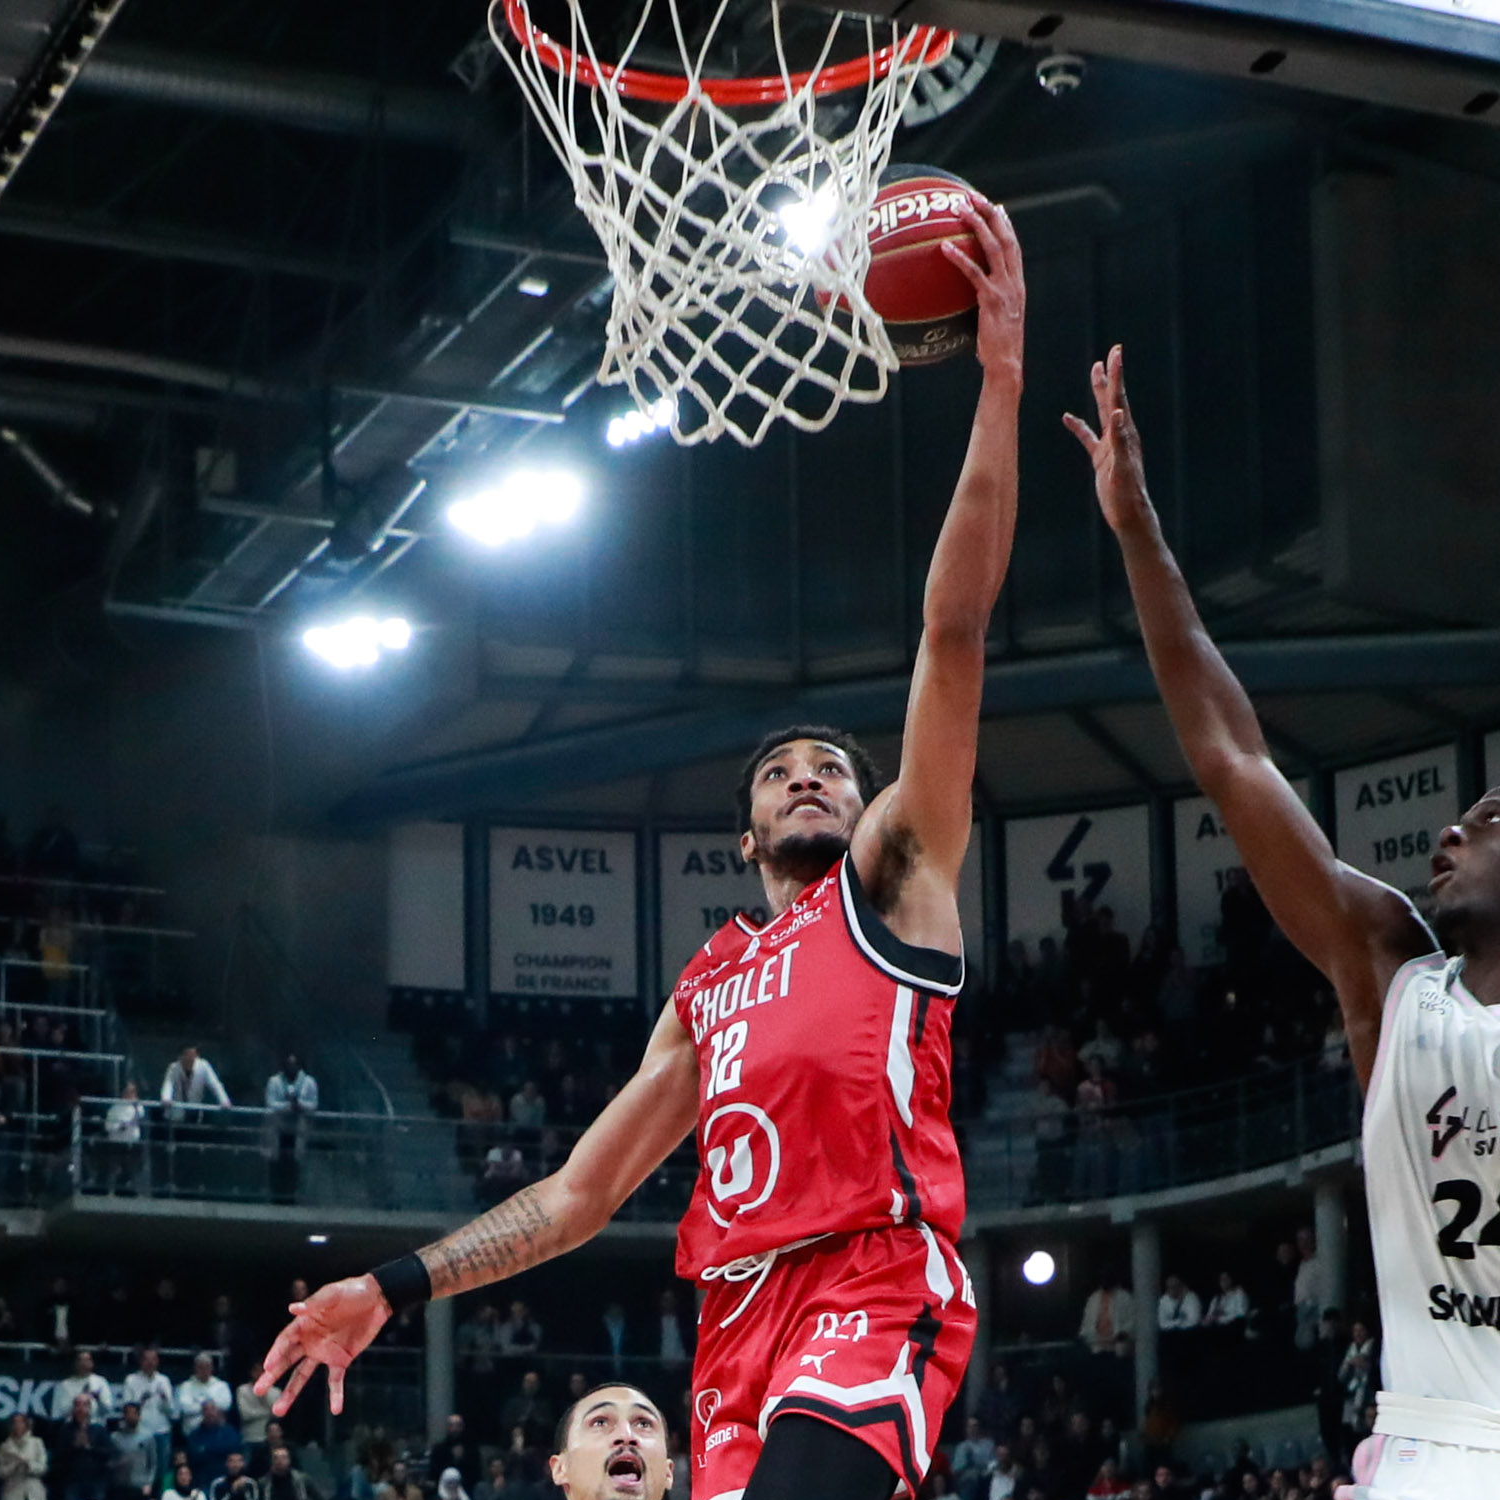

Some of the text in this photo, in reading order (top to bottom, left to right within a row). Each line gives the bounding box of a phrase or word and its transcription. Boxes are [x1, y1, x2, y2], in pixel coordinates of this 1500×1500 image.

[1355, 765, 1445, 811] ASVEL
[511, 845, 613, 874] ASVEL
[682, 849, 760, 875] ASV
[528, 902, 596, 927] 1949
[690, 940, 800, 1045] CHOLET
[706, 1020, 749, 1100] 12
